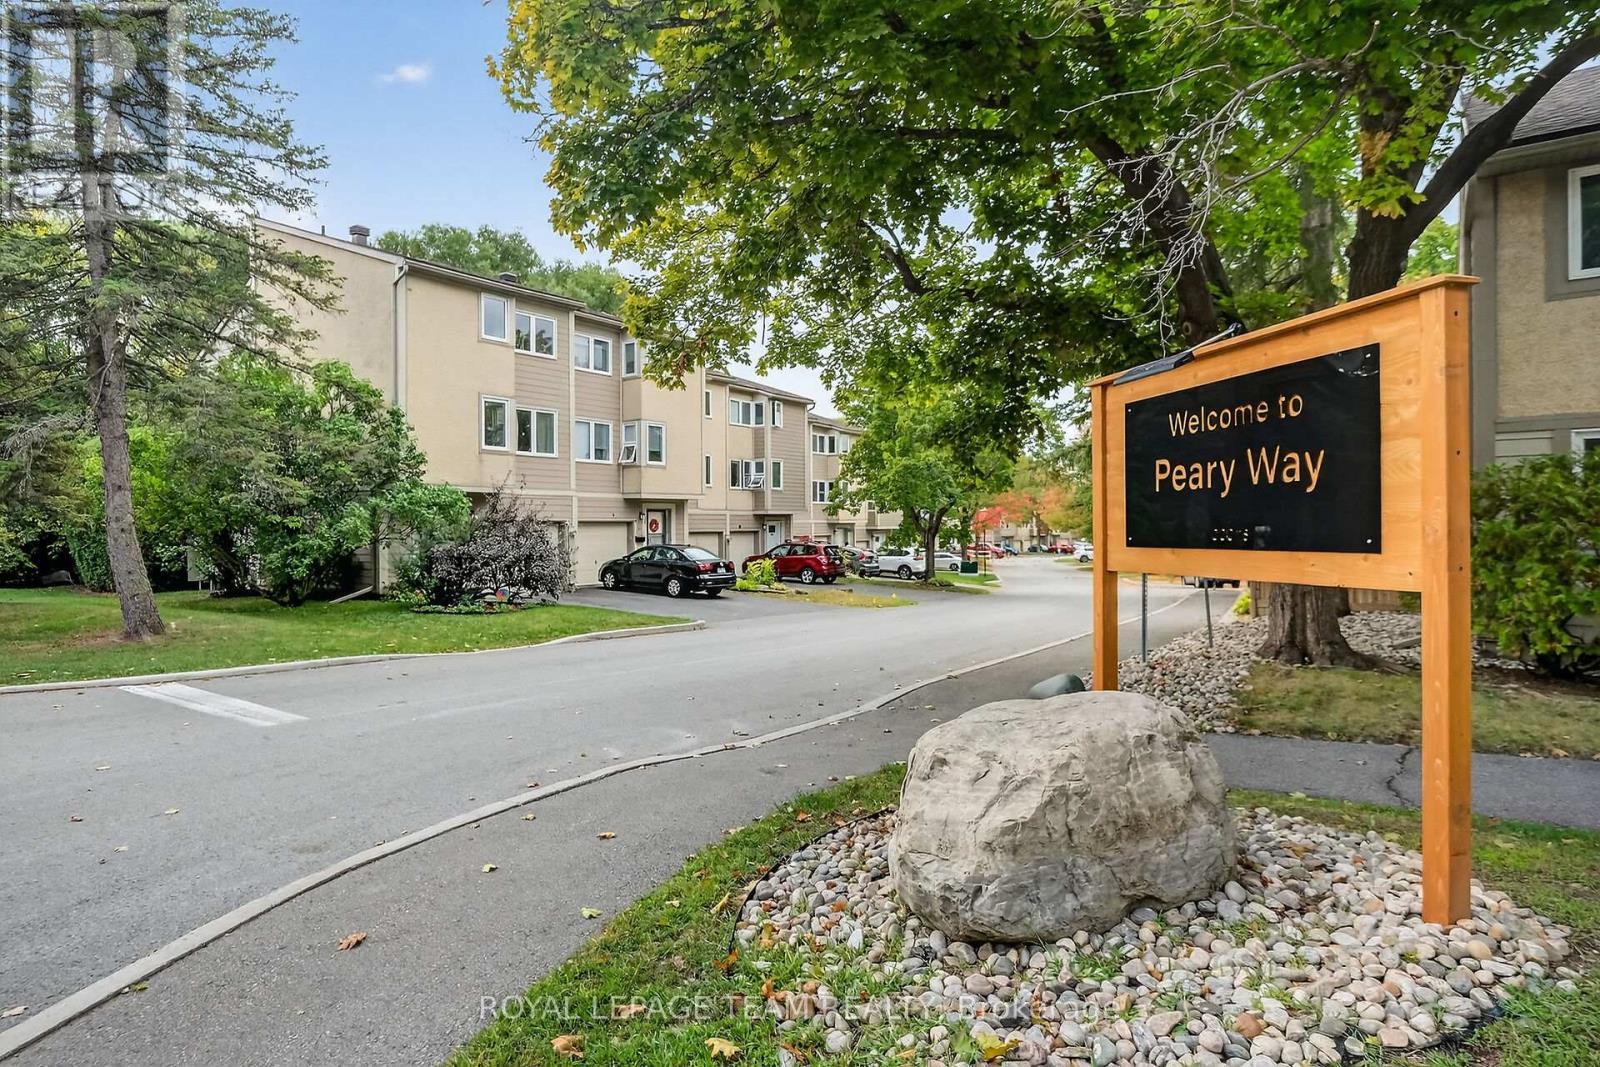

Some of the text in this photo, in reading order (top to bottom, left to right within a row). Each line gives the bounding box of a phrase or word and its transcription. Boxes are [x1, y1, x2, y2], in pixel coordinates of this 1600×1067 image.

[1168, 394, 1303, 437] Welcome to
[1154, 445, 1325, 498] Peary Way
